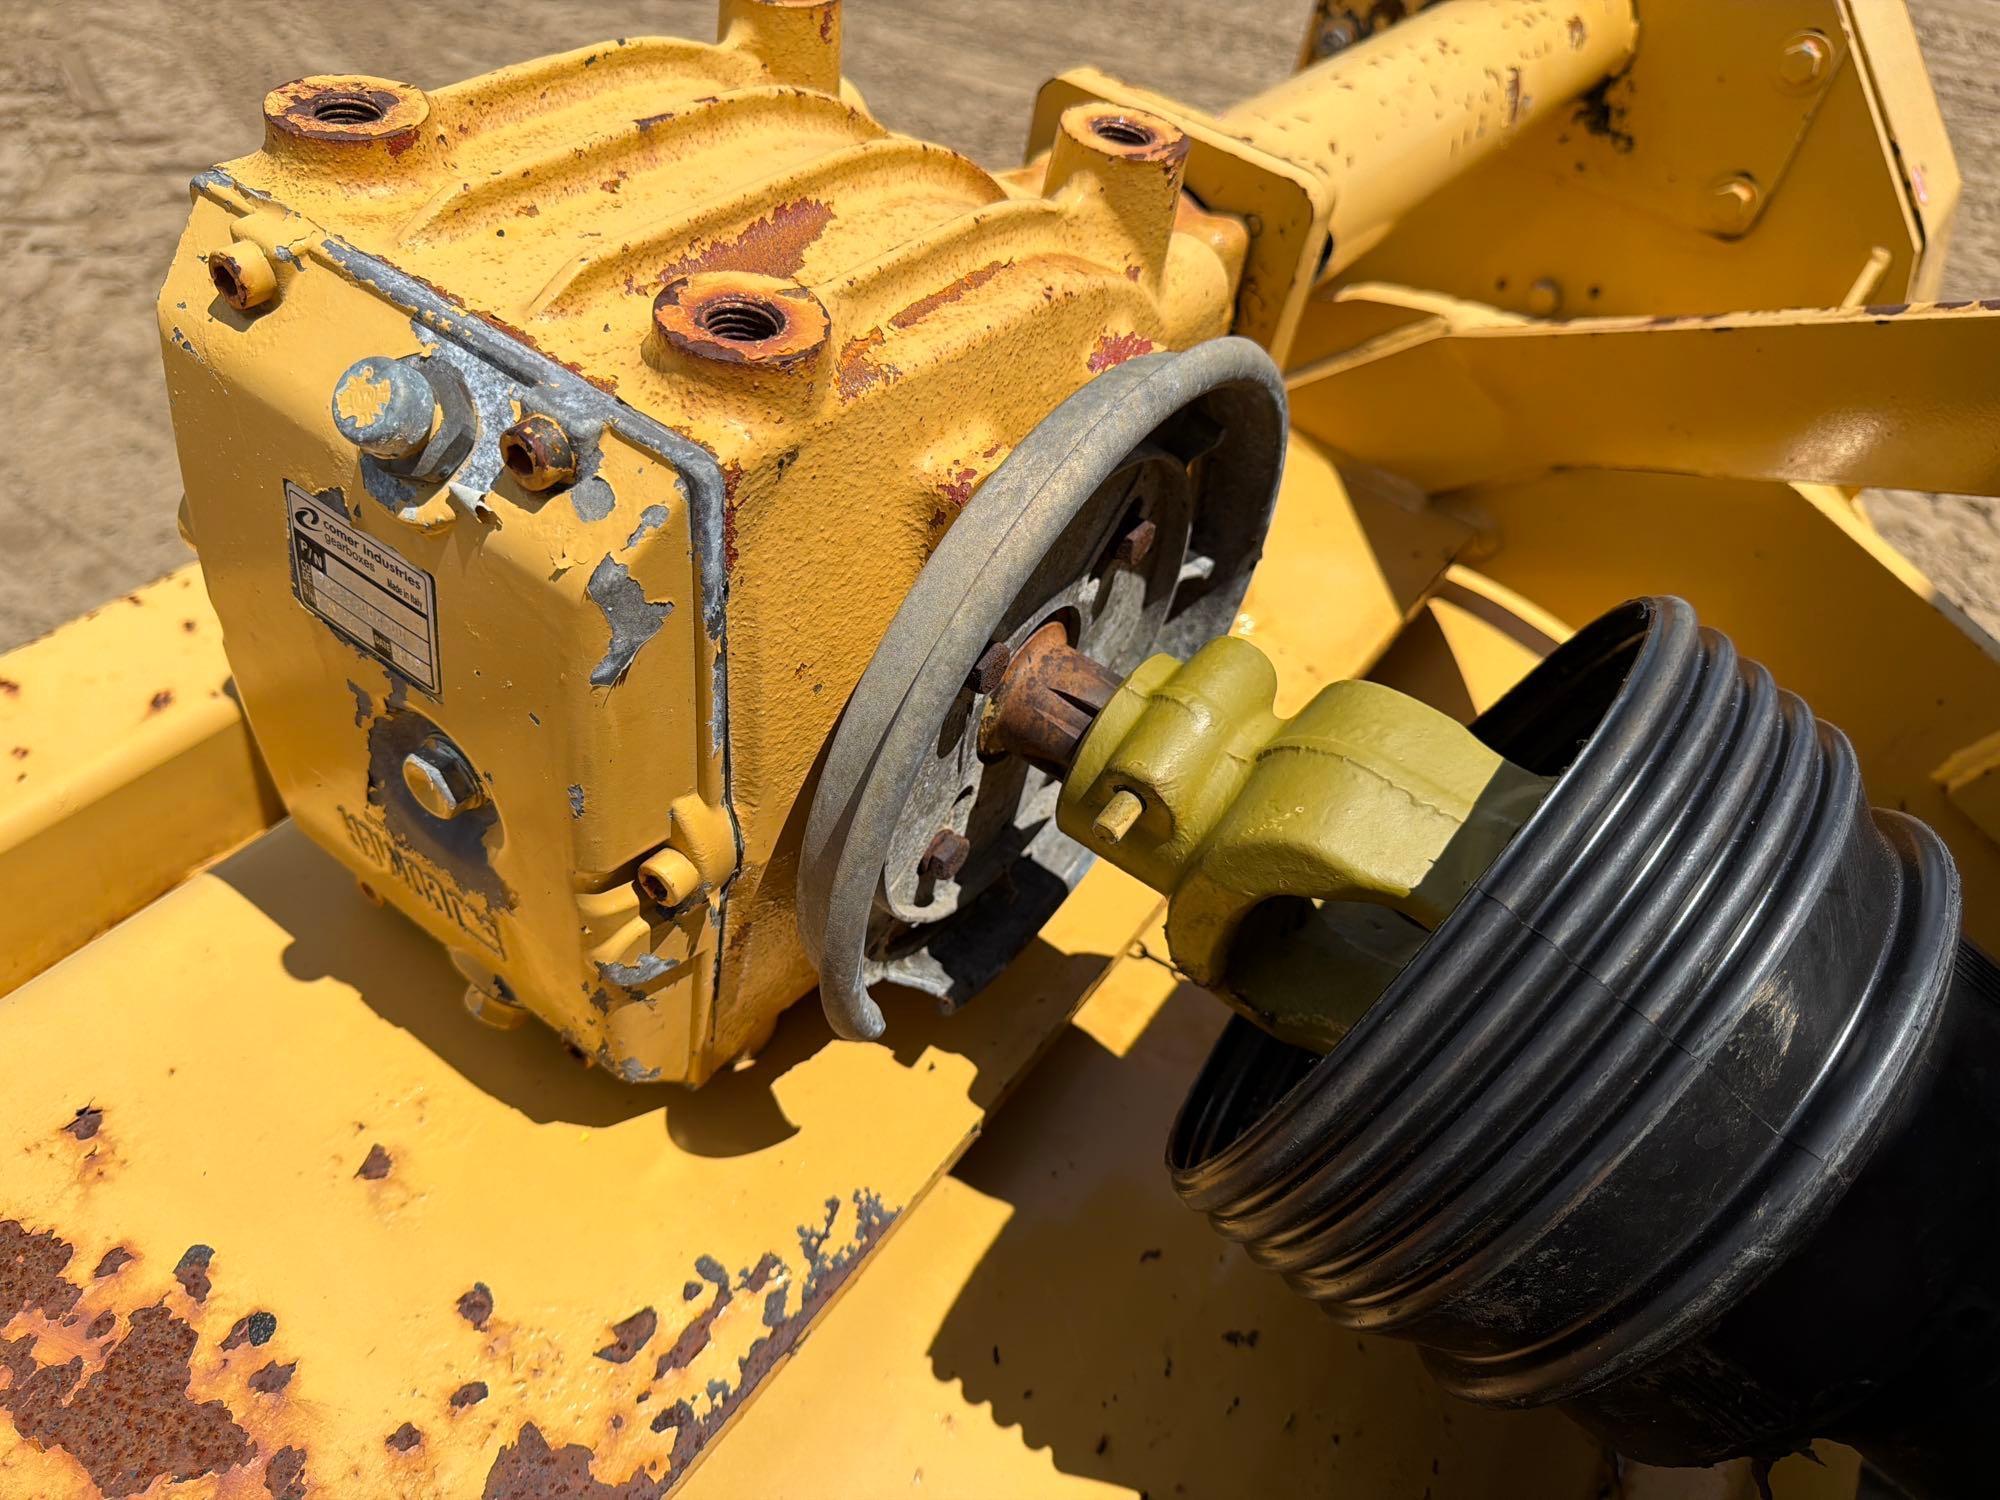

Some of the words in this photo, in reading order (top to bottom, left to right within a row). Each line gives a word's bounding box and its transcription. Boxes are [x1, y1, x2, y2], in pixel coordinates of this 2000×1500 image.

[323, 520, 360, 549] comer
[300, 539, 323, 569] P/N
[324, 533, 376, 573] gearboxes
[386, 578, 403, 596] Made
